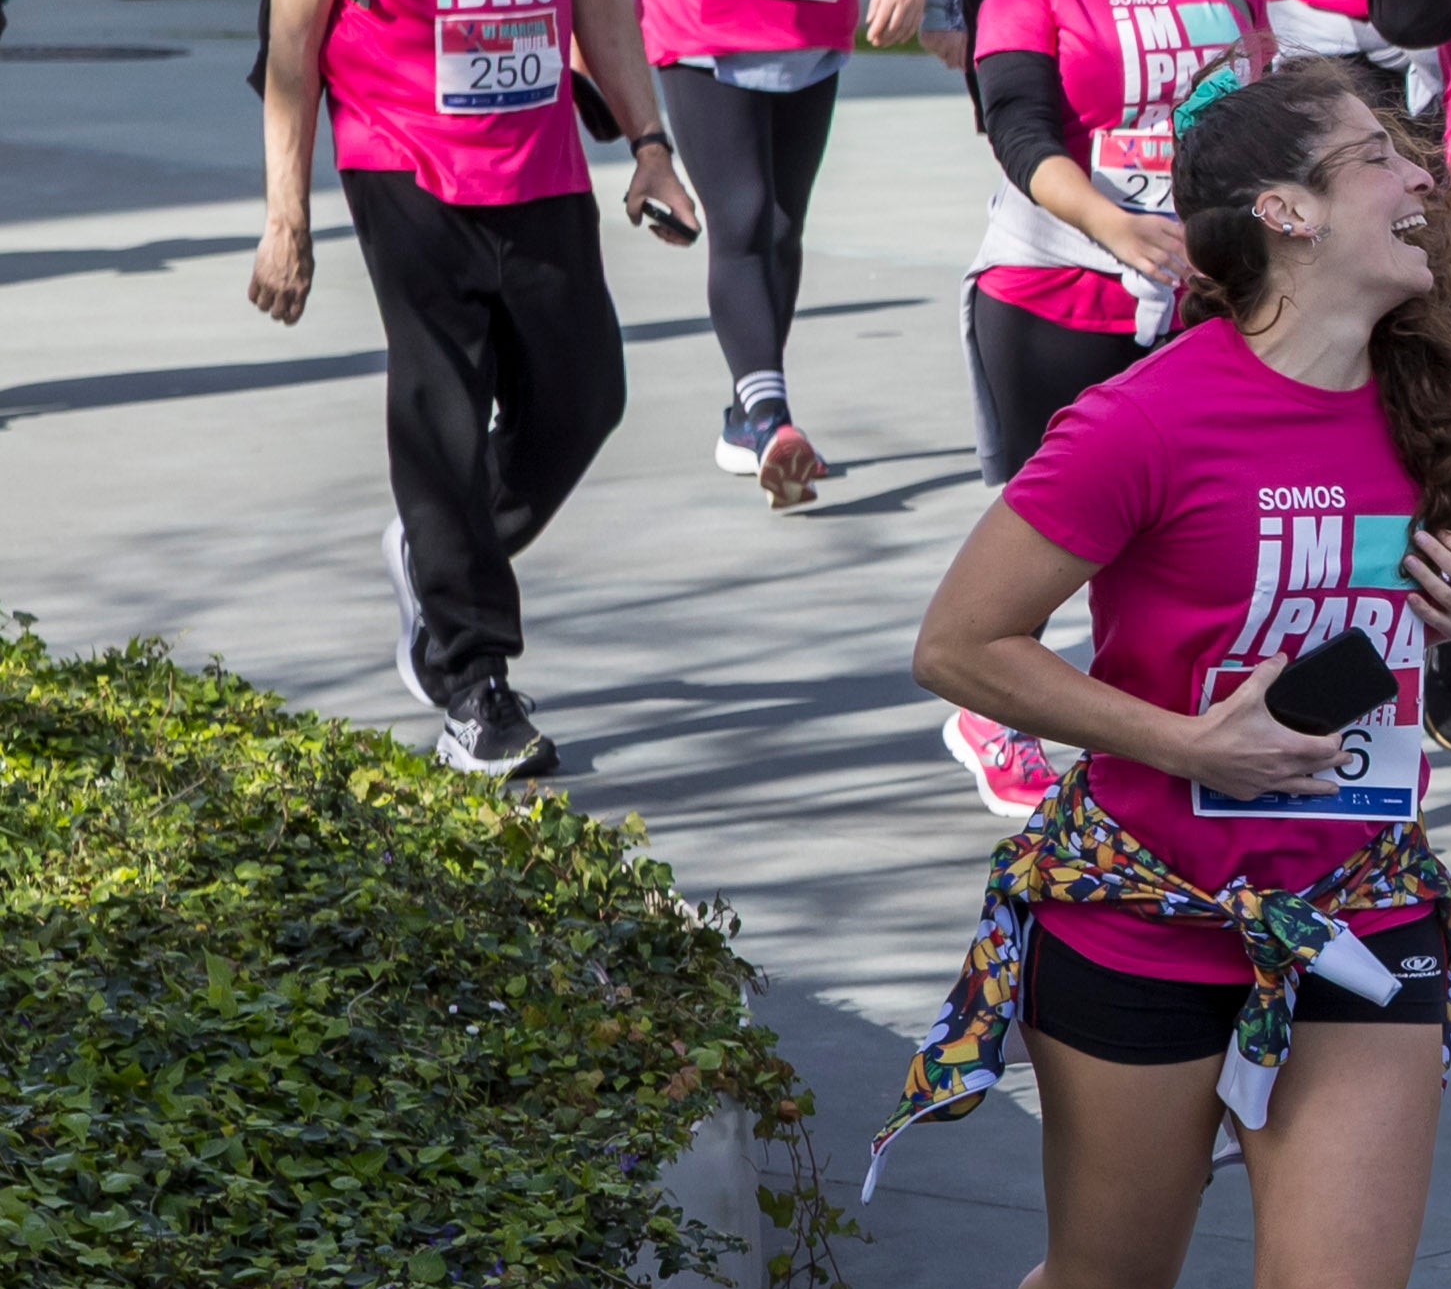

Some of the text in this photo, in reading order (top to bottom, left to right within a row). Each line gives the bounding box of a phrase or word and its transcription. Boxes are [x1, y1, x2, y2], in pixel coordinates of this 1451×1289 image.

[470, 53, 541, 89] 250
[1124, 174, 1171, 207] 27
[1258, 486, 1346, 511] SOMOS
